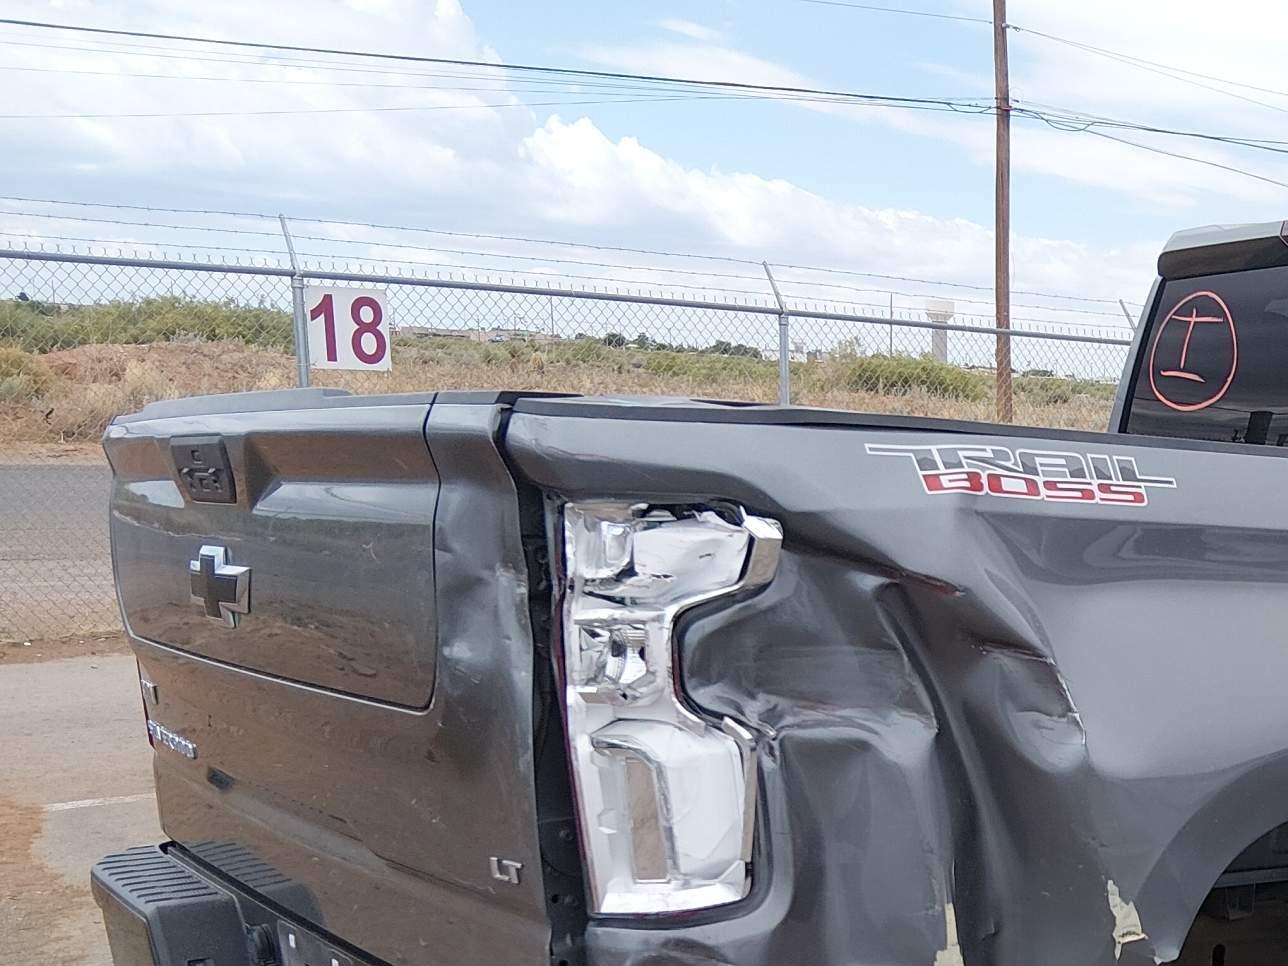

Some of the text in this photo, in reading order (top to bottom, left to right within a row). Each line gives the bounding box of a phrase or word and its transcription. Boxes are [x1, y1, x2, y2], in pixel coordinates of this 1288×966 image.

[309, 293, 387, 365] 18
[864, 443, 1177, 488] TRAIL
[921, 470, 1148, 507] BOSS
[489, 856, 522, 884] LT
